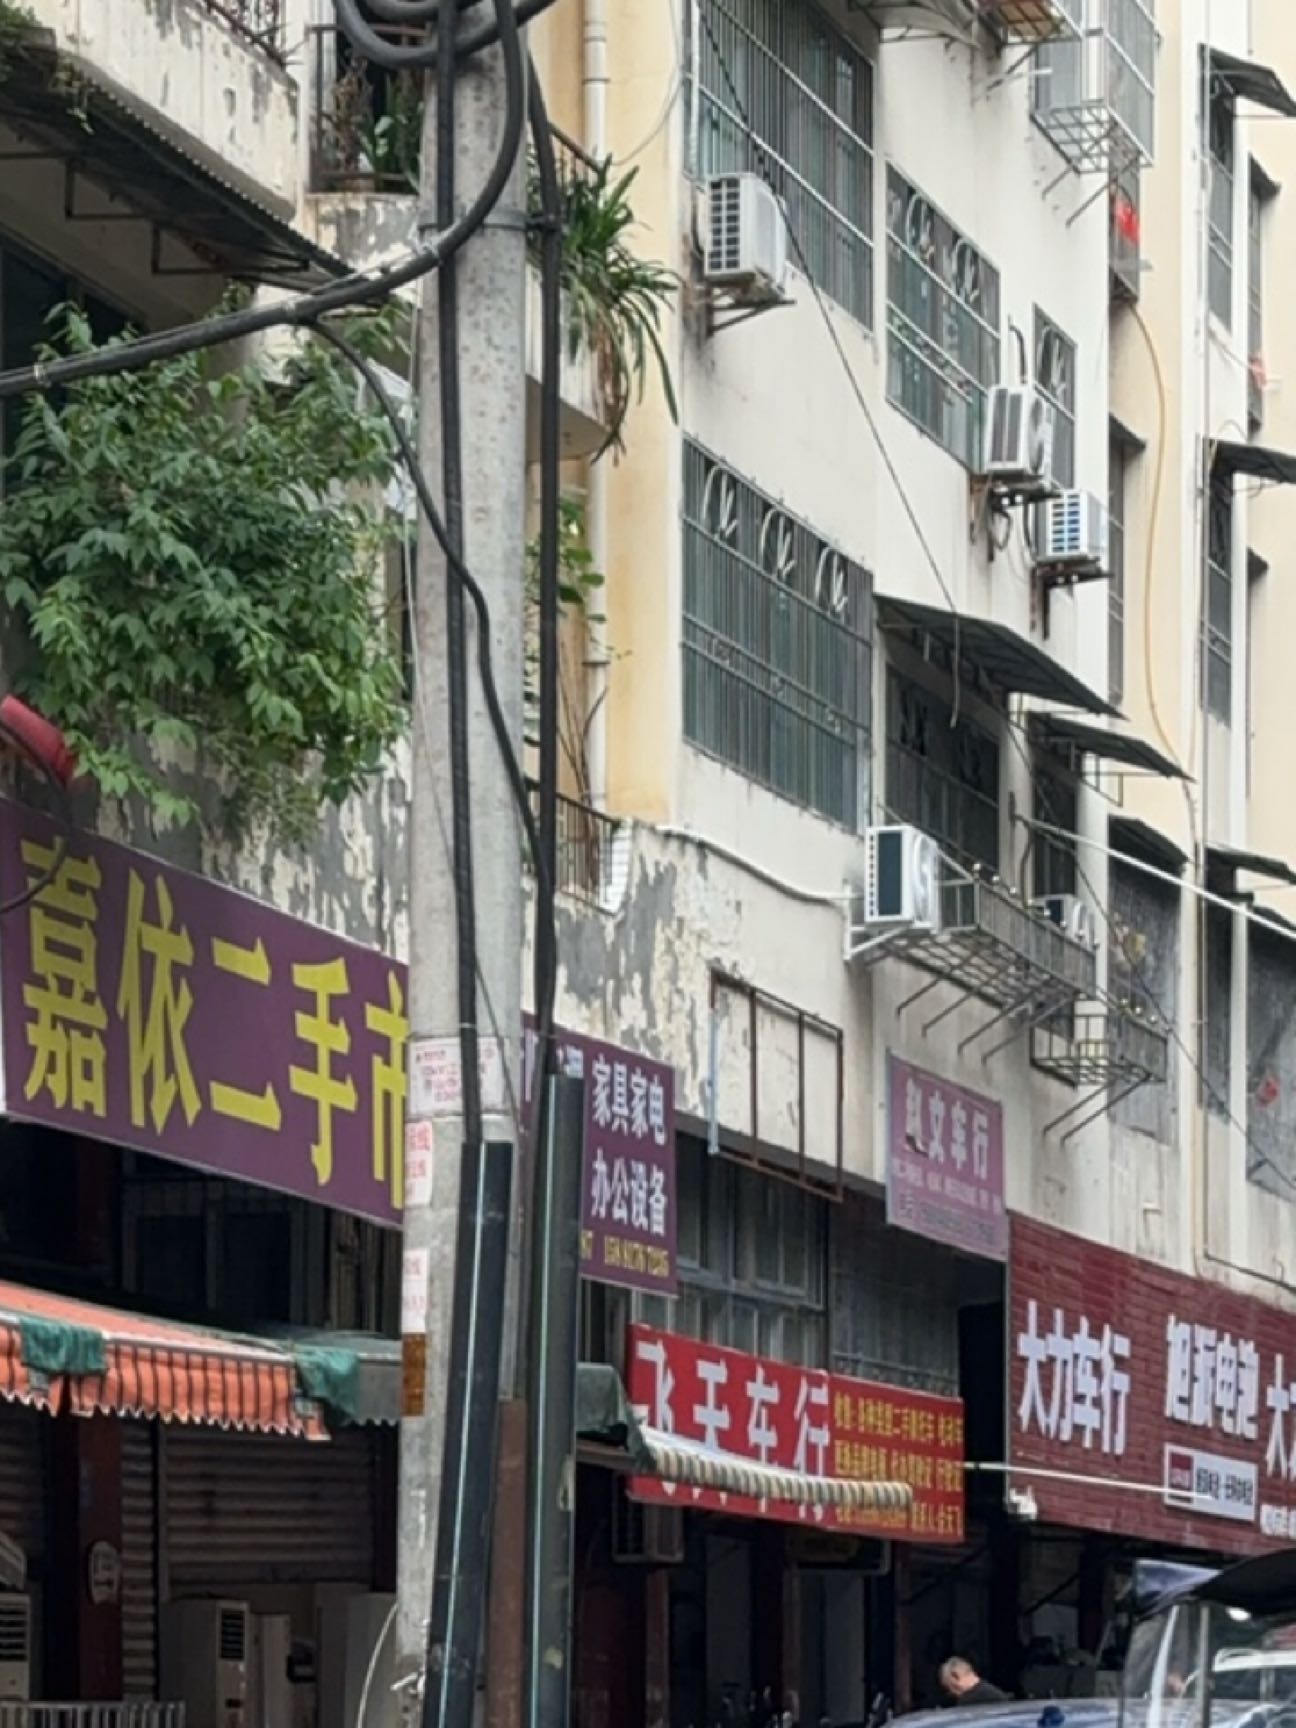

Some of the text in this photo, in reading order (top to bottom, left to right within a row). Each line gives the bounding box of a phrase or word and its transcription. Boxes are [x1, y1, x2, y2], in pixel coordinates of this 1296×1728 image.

[591, 1053, 666, 1146] 家具家电
[590, 1146, 667, 1237] 办公设备
[1017, 1299, 1131, 1455] 大力车行
[1266, 1353, 1296, 1482] 大
